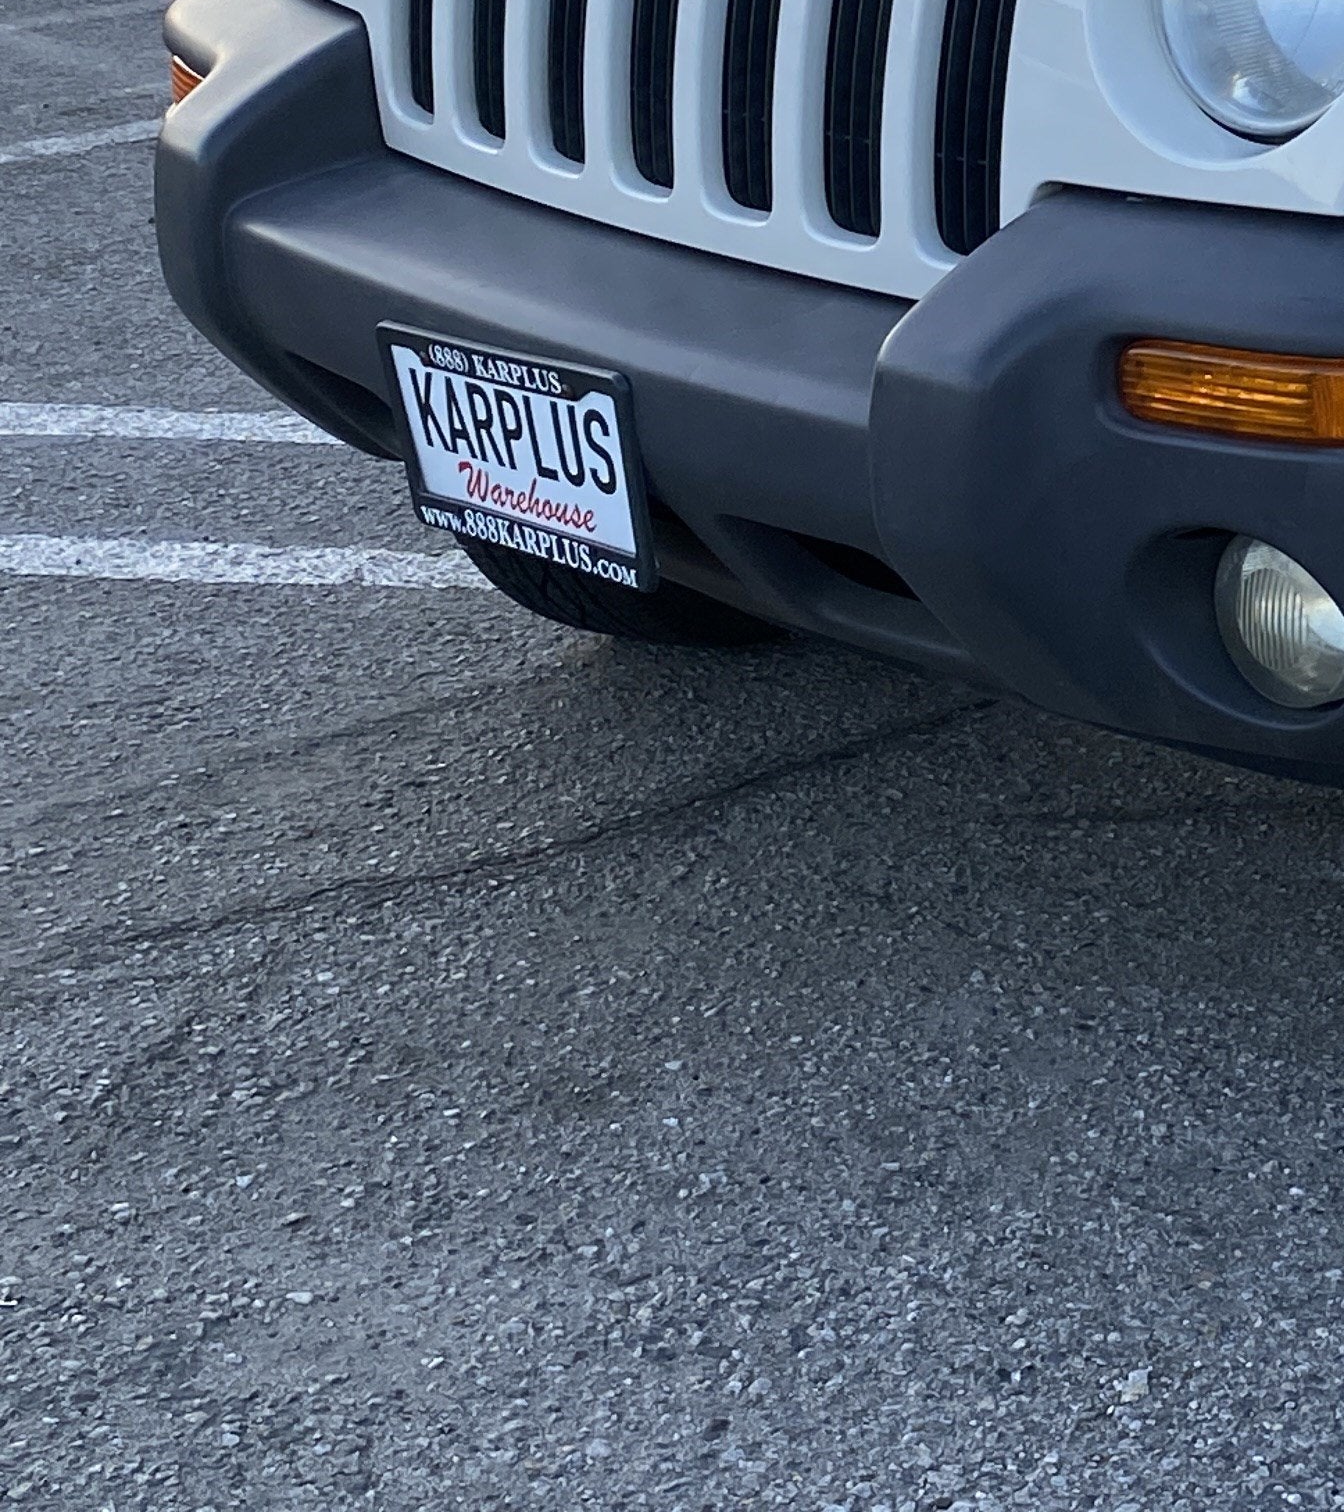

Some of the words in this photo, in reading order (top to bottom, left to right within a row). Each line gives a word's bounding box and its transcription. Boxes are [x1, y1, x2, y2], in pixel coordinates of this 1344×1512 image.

[428, 343, 469, 373] (888)
[471, 354, 562, 394] KARPLUS
[408, 367, 617, 495] KARPLUS
[458, 460, 597, 533] Warehouse
